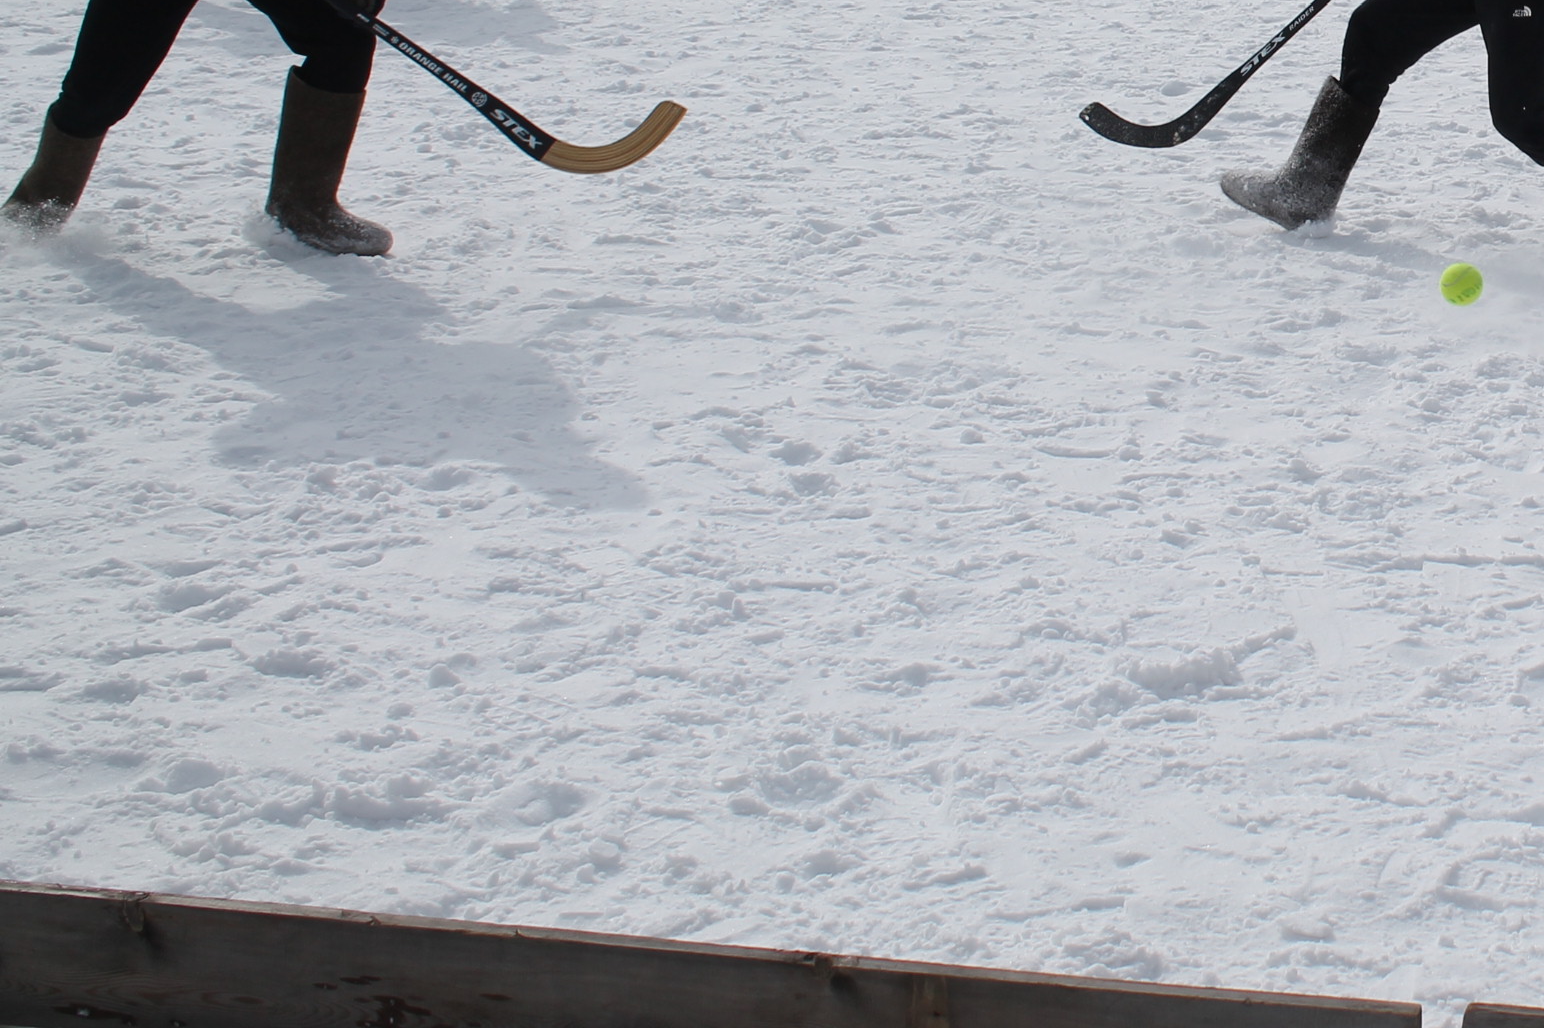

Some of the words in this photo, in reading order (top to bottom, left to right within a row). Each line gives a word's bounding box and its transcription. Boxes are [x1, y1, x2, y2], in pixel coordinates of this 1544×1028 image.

[1240, 32, 1286, 77] STEX
[1288, 5, 1315, 31] RAIDER
[399, 42, 444, 75] ORANGE
[442, 73, 468, 92] HAIL
[490, 109, 543, 150] STEX
